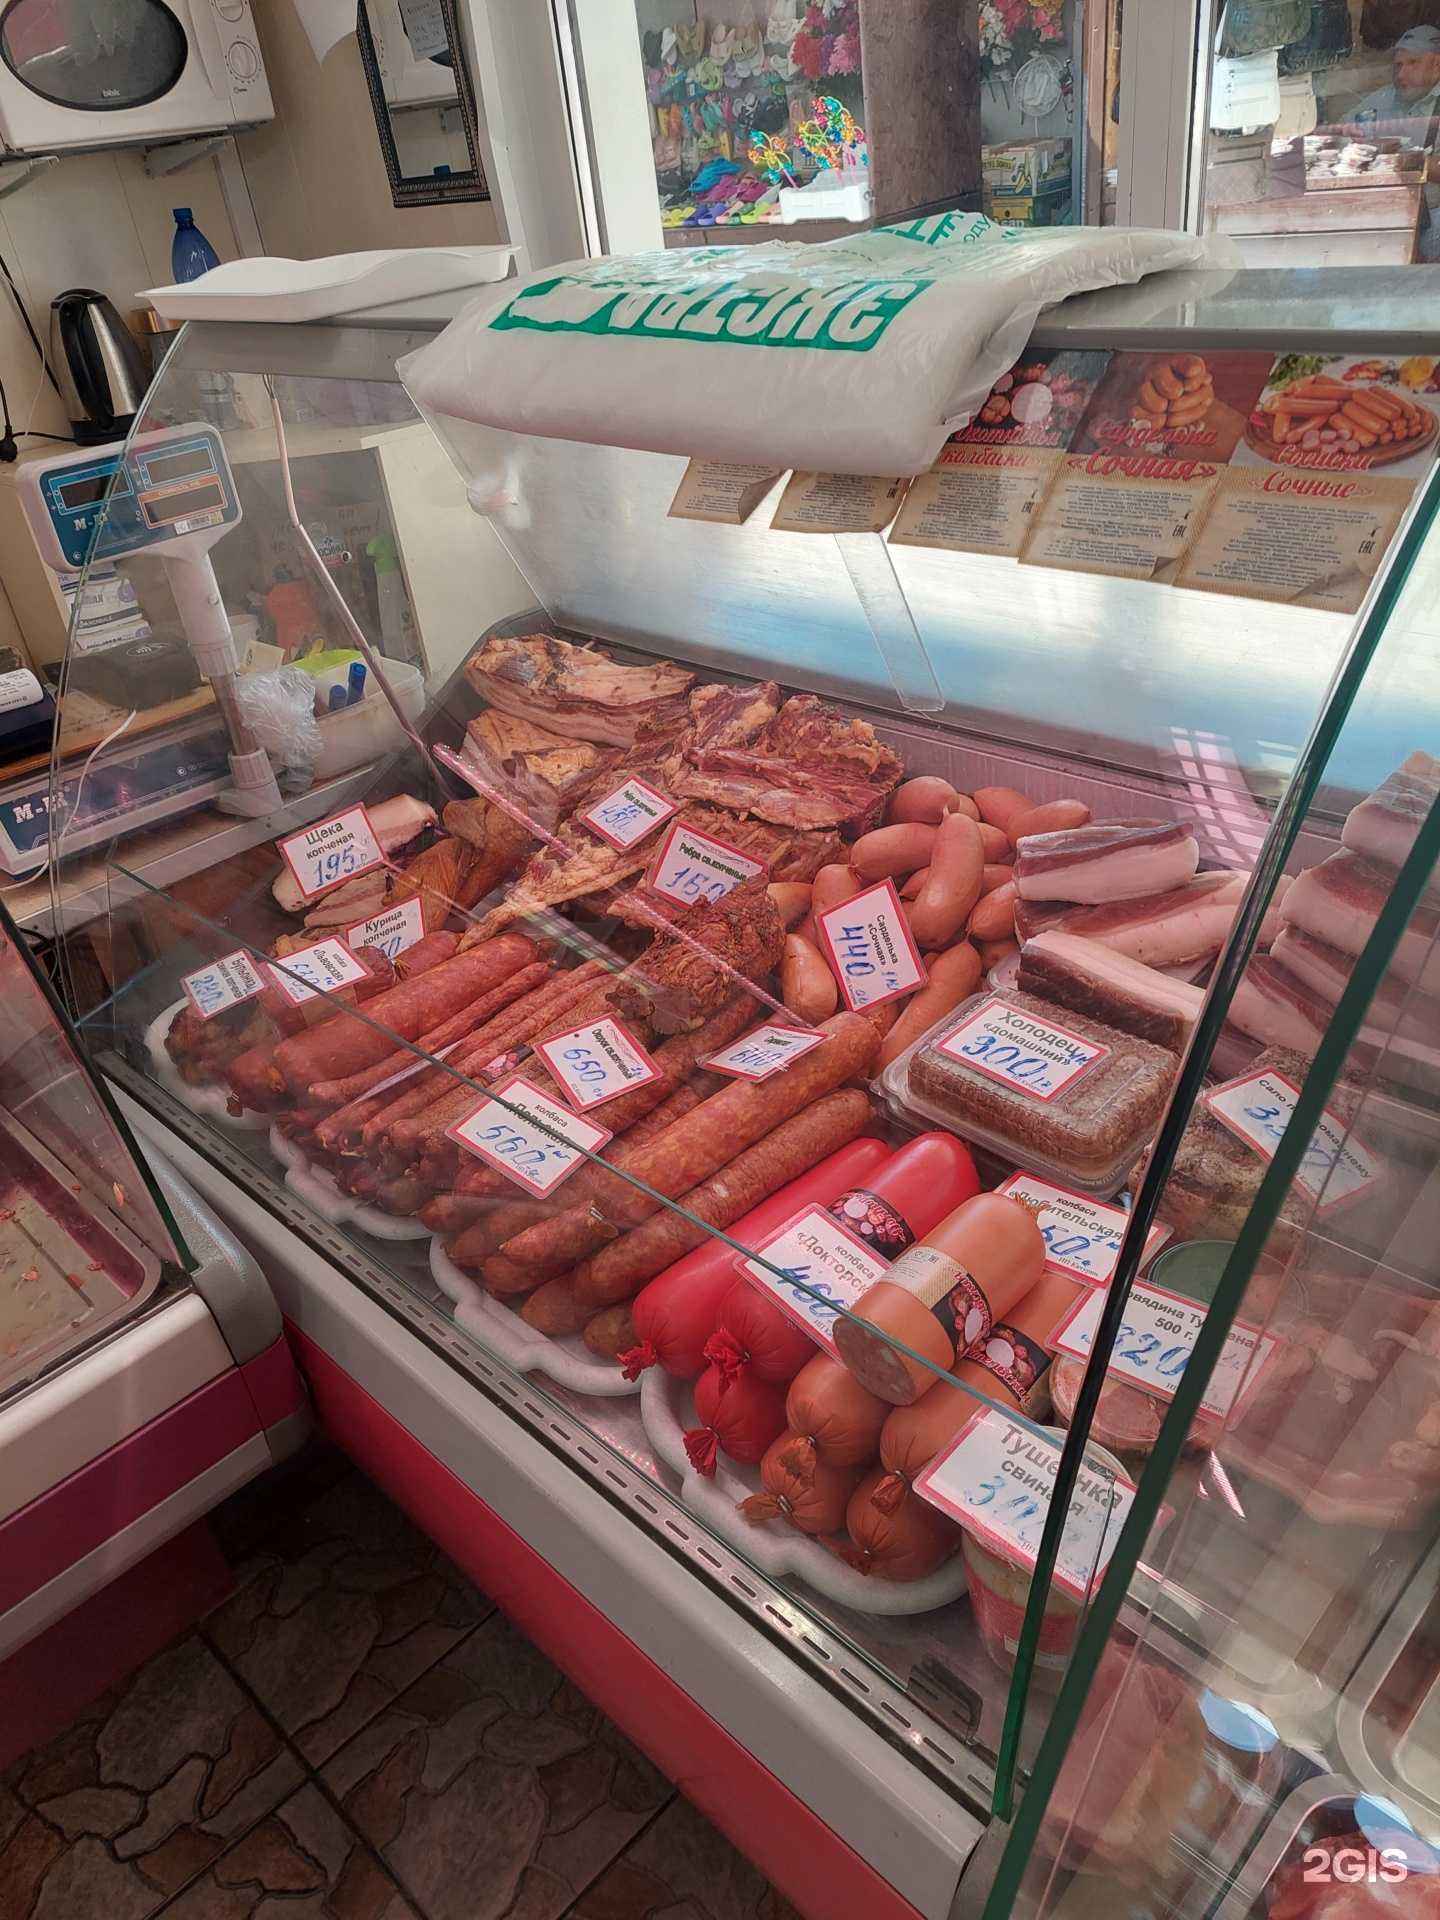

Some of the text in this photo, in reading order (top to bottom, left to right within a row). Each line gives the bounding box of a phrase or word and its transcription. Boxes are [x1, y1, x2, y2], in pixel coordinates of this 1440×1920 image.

[305, 820, 344, 846] Щека
[306, 831, 355, 860] копченая
[314, 844, 356, 888] 195
[363, 919, 407, 948] копченая
[365, 910, 403, 934] Курица
[834, 925, 876, 978] 440
[876, 914, 899, 965] Сарделька
[983, 1022, 1072, 1067] «домашний»
[999, 1011, 1081, 1056] Холодец
[563, 1048, 607, 1083] 650
[1258, 1079, 1287, 1103] Сало
[534, 1103, 569, 1128] колбаса
[1055, 1196, 1097, 1217] колбаса
[796, 1231, 870, 1295] «Докторск
[834, 1244, 876, 1281] колбаса
[1128, 1291, 1185, 1320] овядина
[1154, 1317, 1182, 1335] 500
